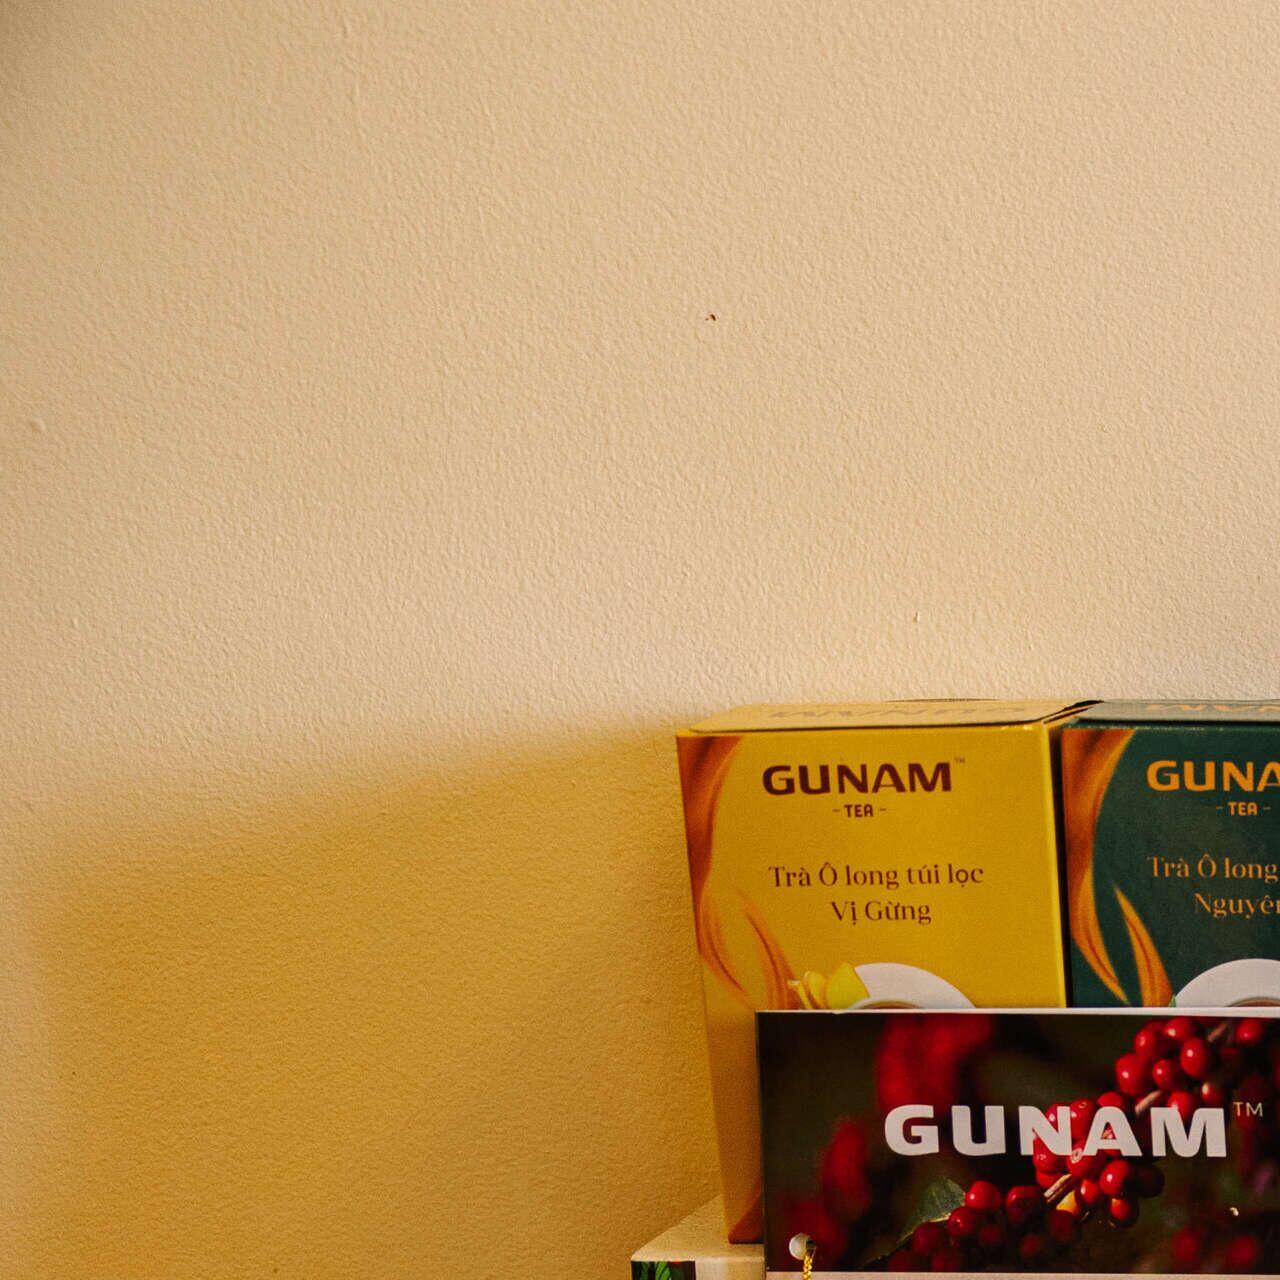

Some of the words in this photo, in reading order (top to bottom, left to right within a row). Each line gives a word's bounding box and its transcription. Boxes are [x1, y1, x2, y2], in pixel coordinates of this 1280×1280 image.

[762, 762, 952, 795] GUNAM
[844, 804, 874, 818] TEA
[1227, 801, 1258, 816] TEA
[768, 866, 811, 887] Trà
[818, 861, 838, 887] Ô
[846, 864, 899, 890] long
[906, 863, 940, 885] túi
[948, 863, 984, 888] lọc
[1146, 856, 1190, 878] Trà
[1197, 853, 1217, 878] Ô
[1224, 857, 1278, 884] long
[831, 900, 857, 925] Vị
[865, 900, 932, 926] Gừng
[884, 1103, 1227, 1158] GUNAM
